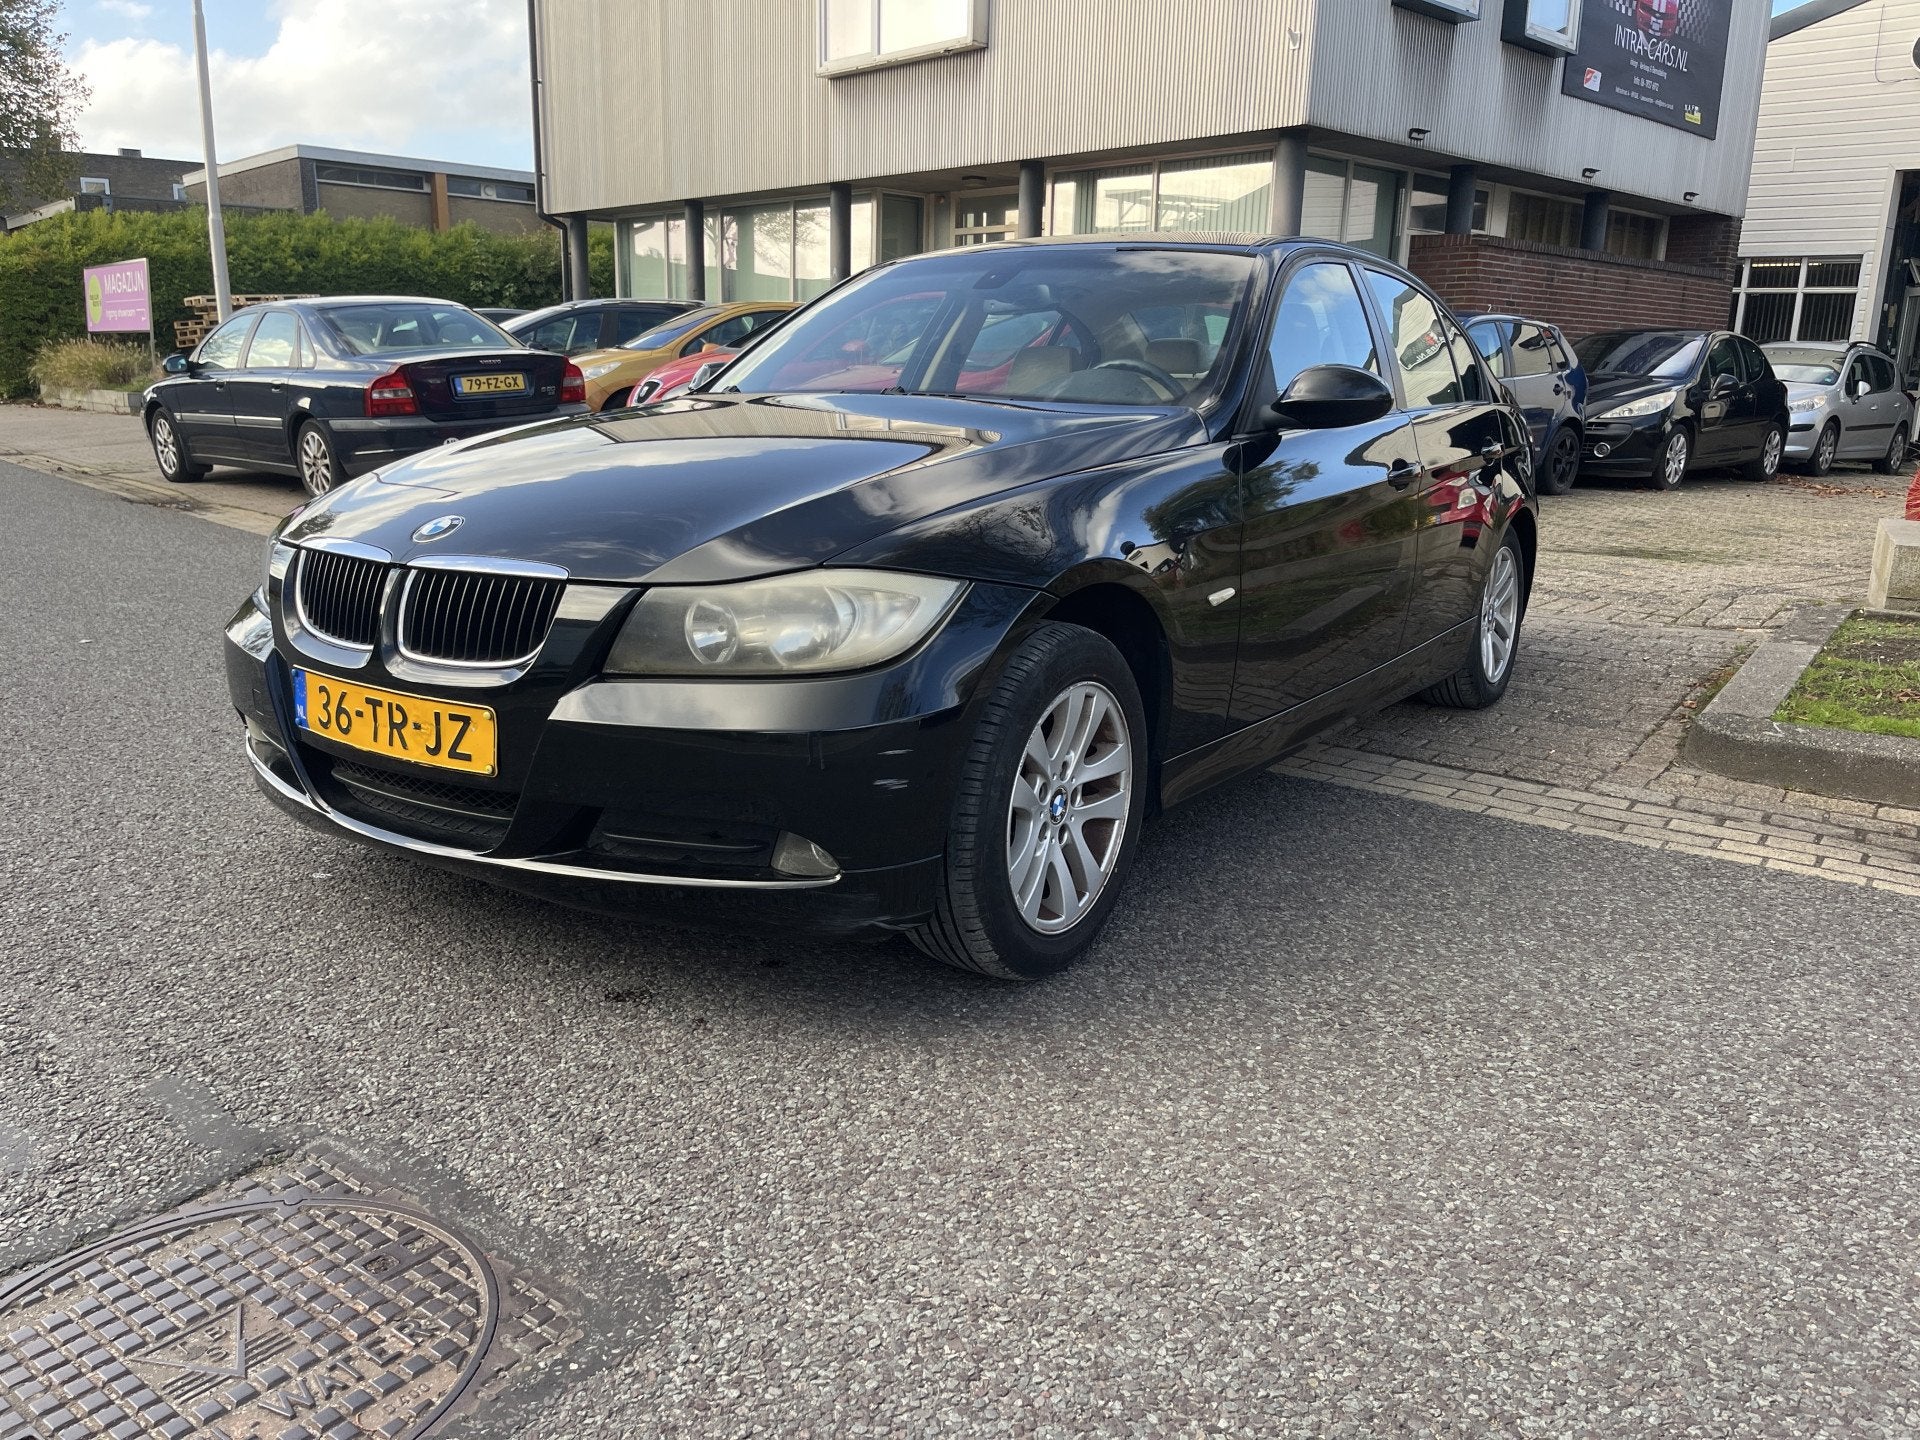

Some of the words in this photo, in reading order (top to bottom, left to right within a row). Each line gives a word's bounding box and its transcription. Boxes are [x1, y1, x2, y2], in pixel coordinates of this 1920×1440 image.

[1615, 24, 1688, 72] INTRA-CARS.NL
[104, 270, 144, 294] MAGAZIJN
[467, 376, 519, 391] 79-FZ-GX
[318, 685, 472, 762] 36-TR-JZ
